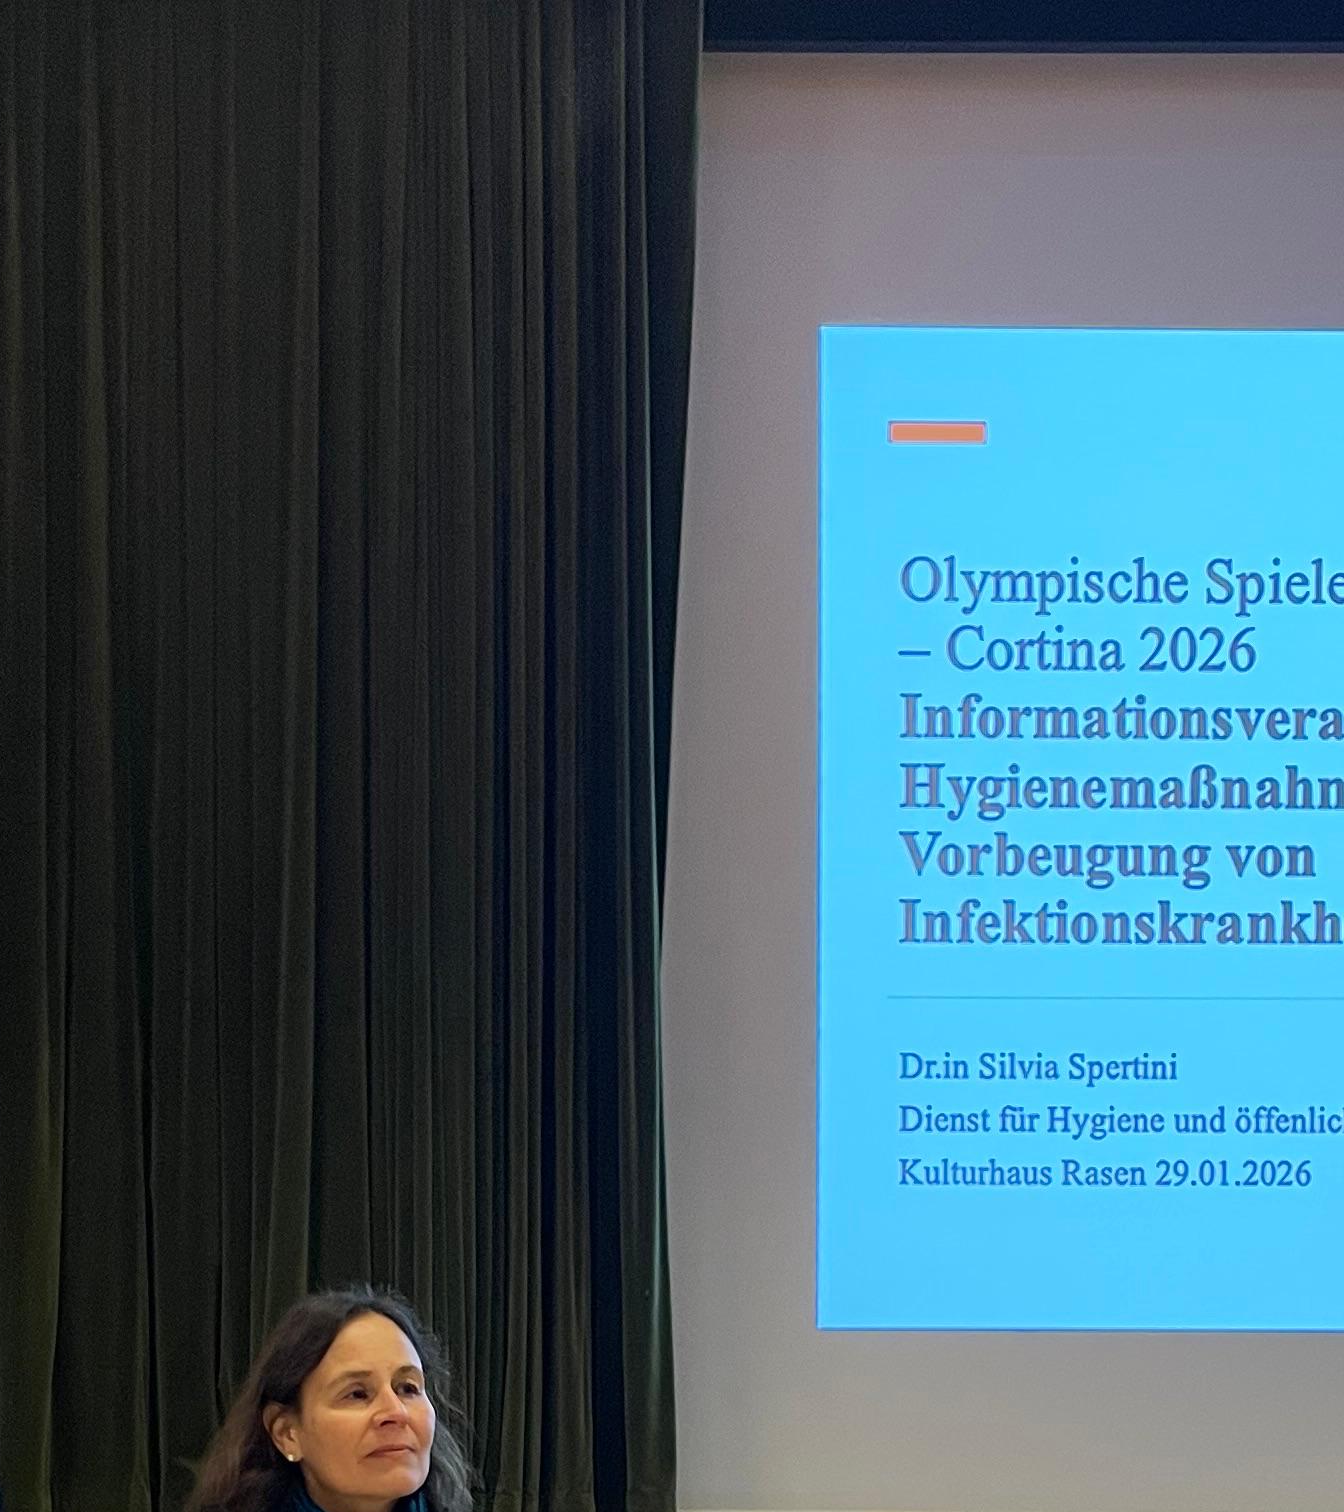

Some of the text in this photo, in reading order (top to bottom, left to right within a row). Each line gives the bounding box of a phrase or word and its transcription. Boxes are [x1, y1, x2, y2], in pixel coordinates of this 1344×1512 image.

[900, 555, 1189, 616] Olympische
[946, 624, 1126, 673] Cortina
[1138, 626, 1257, 673] 2026
[898, 830, 1317, 890] Vorbeugung von
[899, 1051, 1178, 1087] Dr.in Silvia Spertini
[898, 1104, 991, 1133] Dienst
[998, 1104, 1041, 1133] für
[1046, 1104, 1165, 1141] Hygiene
[1173, 1105, 1227, 1134] und
[898, 1158, 1312, 1188] Kulturhaus Rasen 29.01.2026
